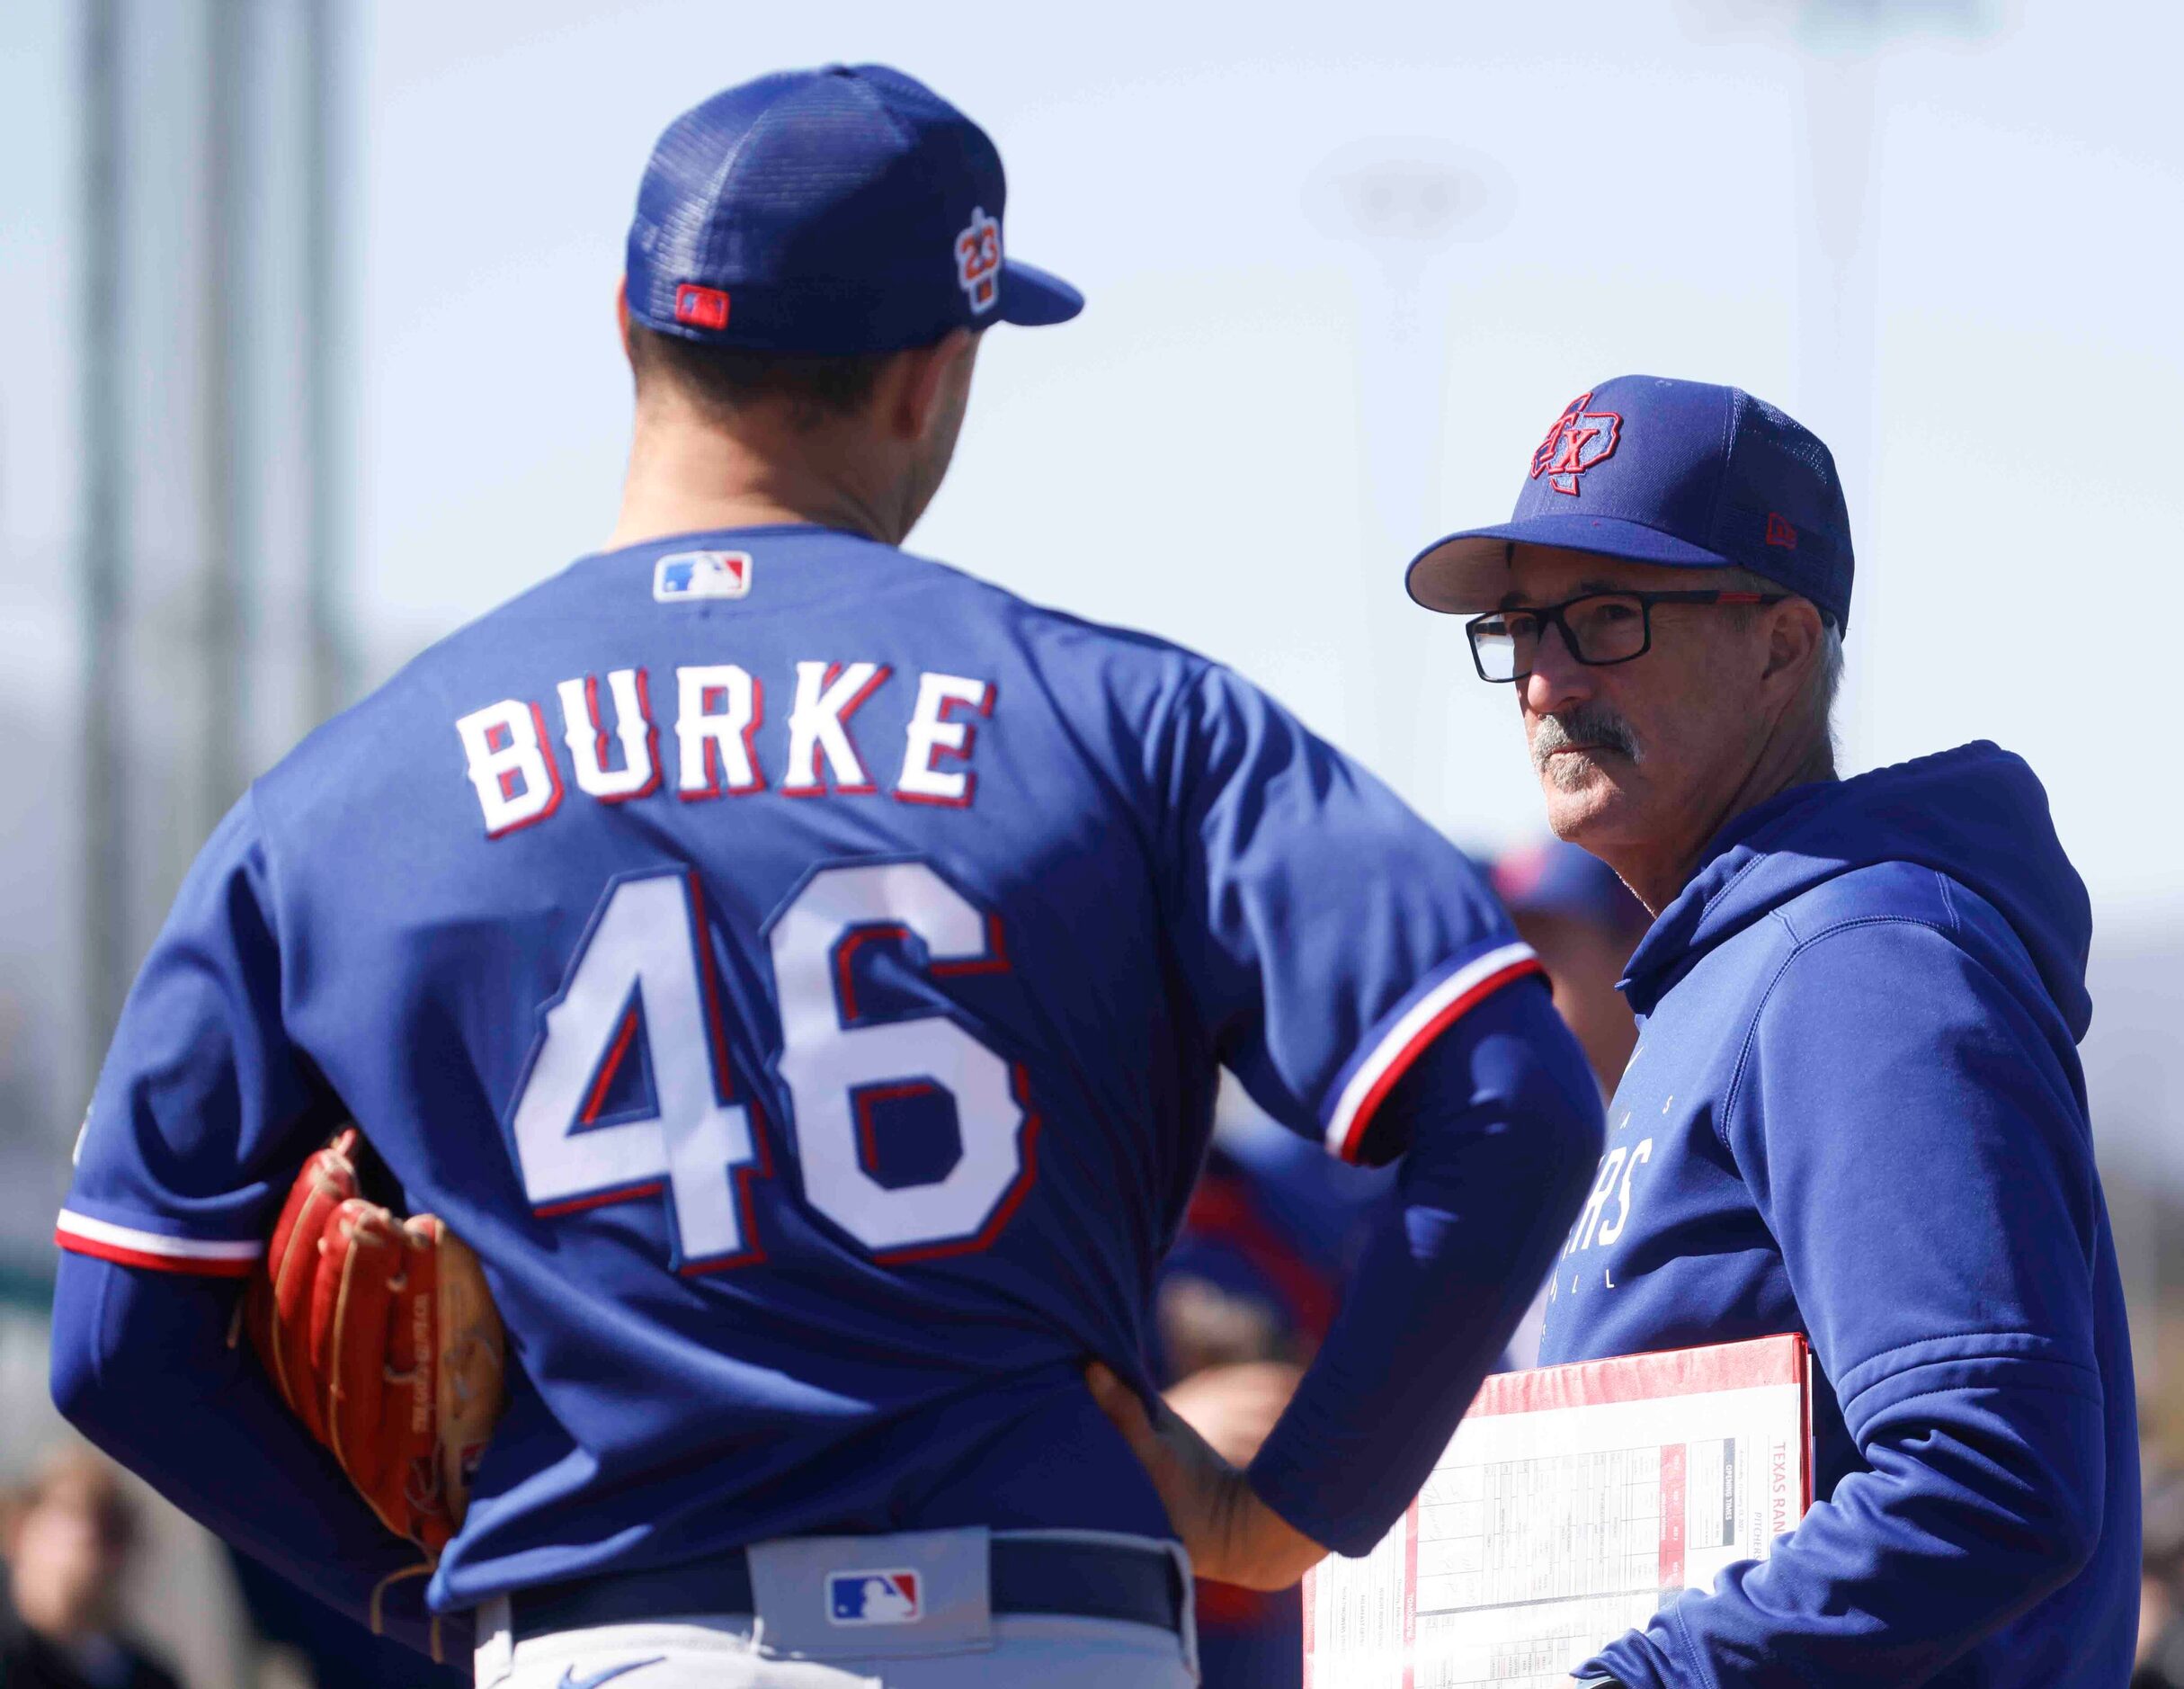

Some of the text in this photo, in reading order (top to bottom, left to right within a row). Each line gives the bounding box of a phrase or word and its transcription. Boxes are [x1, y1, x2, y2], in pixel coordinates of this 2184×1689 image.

[456, 661, 997, 840] BURKE
[511, 860, 1042, 1272] 46
[1725, 1464, 1733, 1521] OPENING TIMES
[1772, 1441, 1787, 1493] TEXAS
[1752, 1511, 1763, 1559] PITCHERS
[1405, 1595, 1414, 1639] TOMORROW
